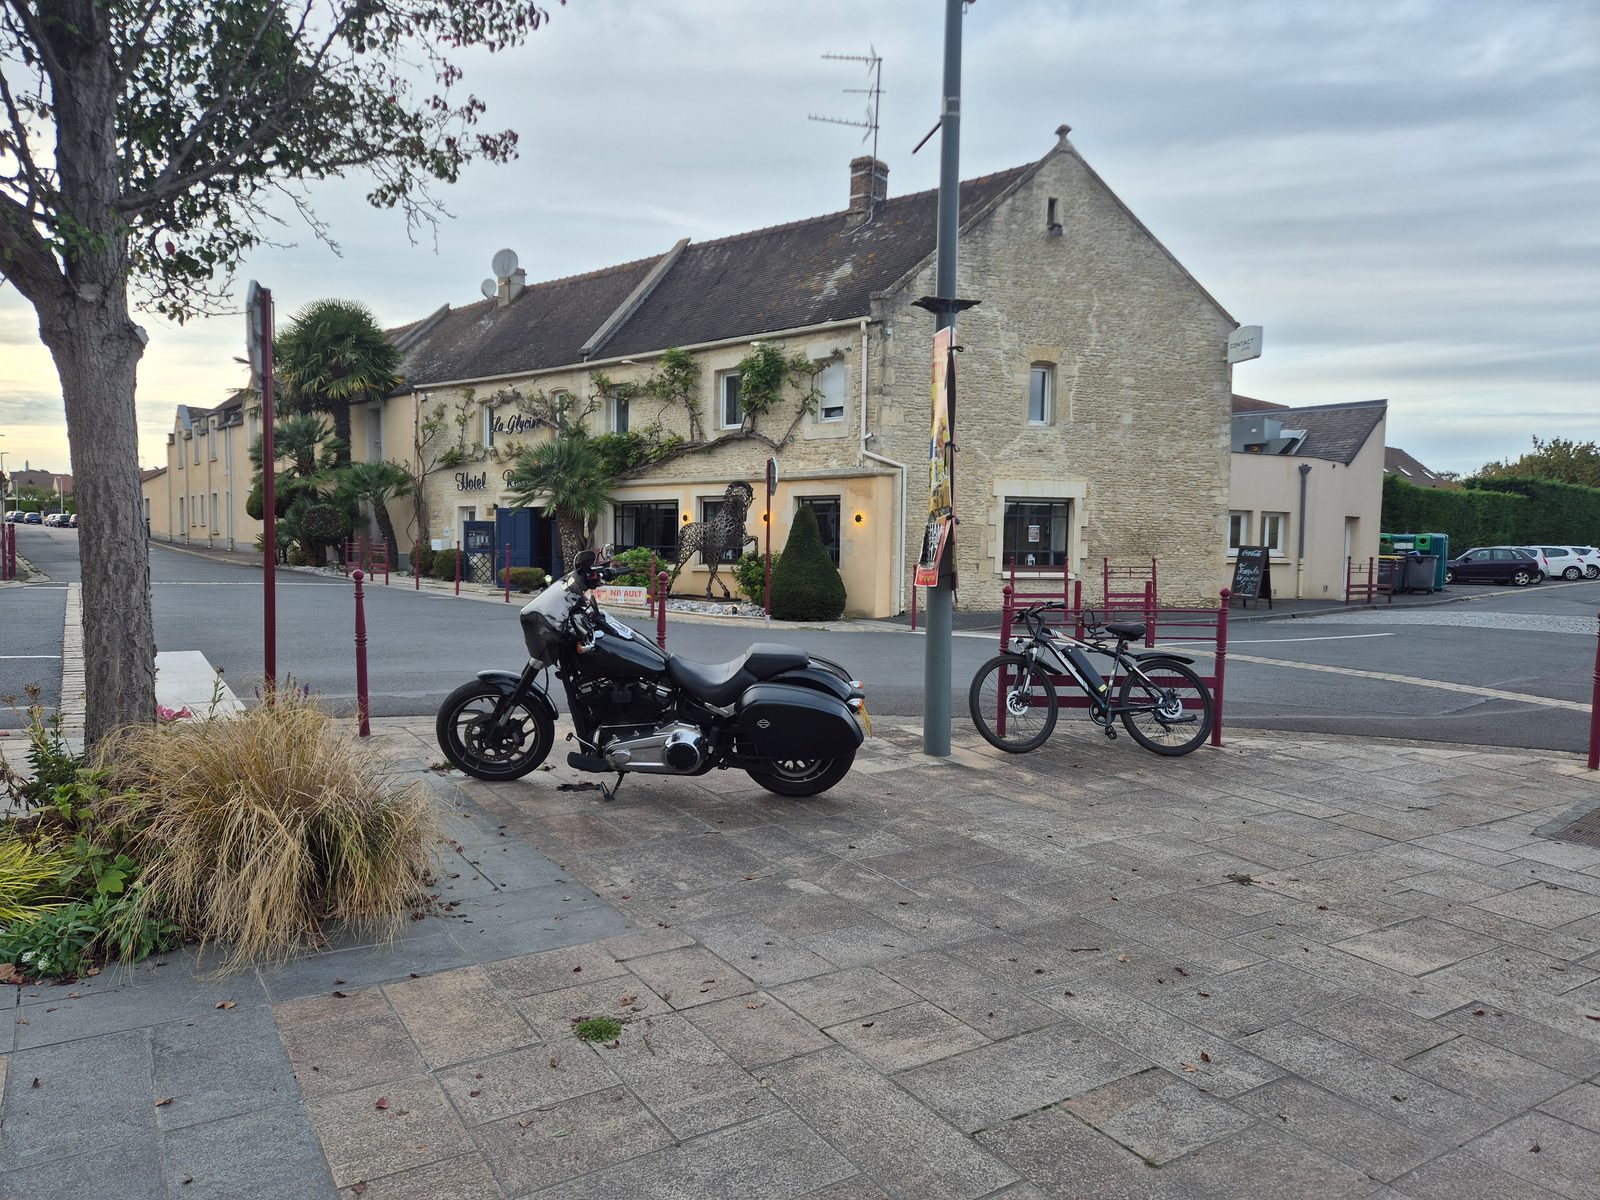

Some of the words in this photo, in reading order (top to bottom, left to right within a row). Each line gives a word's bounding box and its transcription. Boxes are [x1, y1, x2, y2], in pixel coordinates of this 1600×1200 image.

[491, 416, 504, 433] La
[506, 414, 541, 435] Glycine
[455, 472, 487, 491] Hotel
